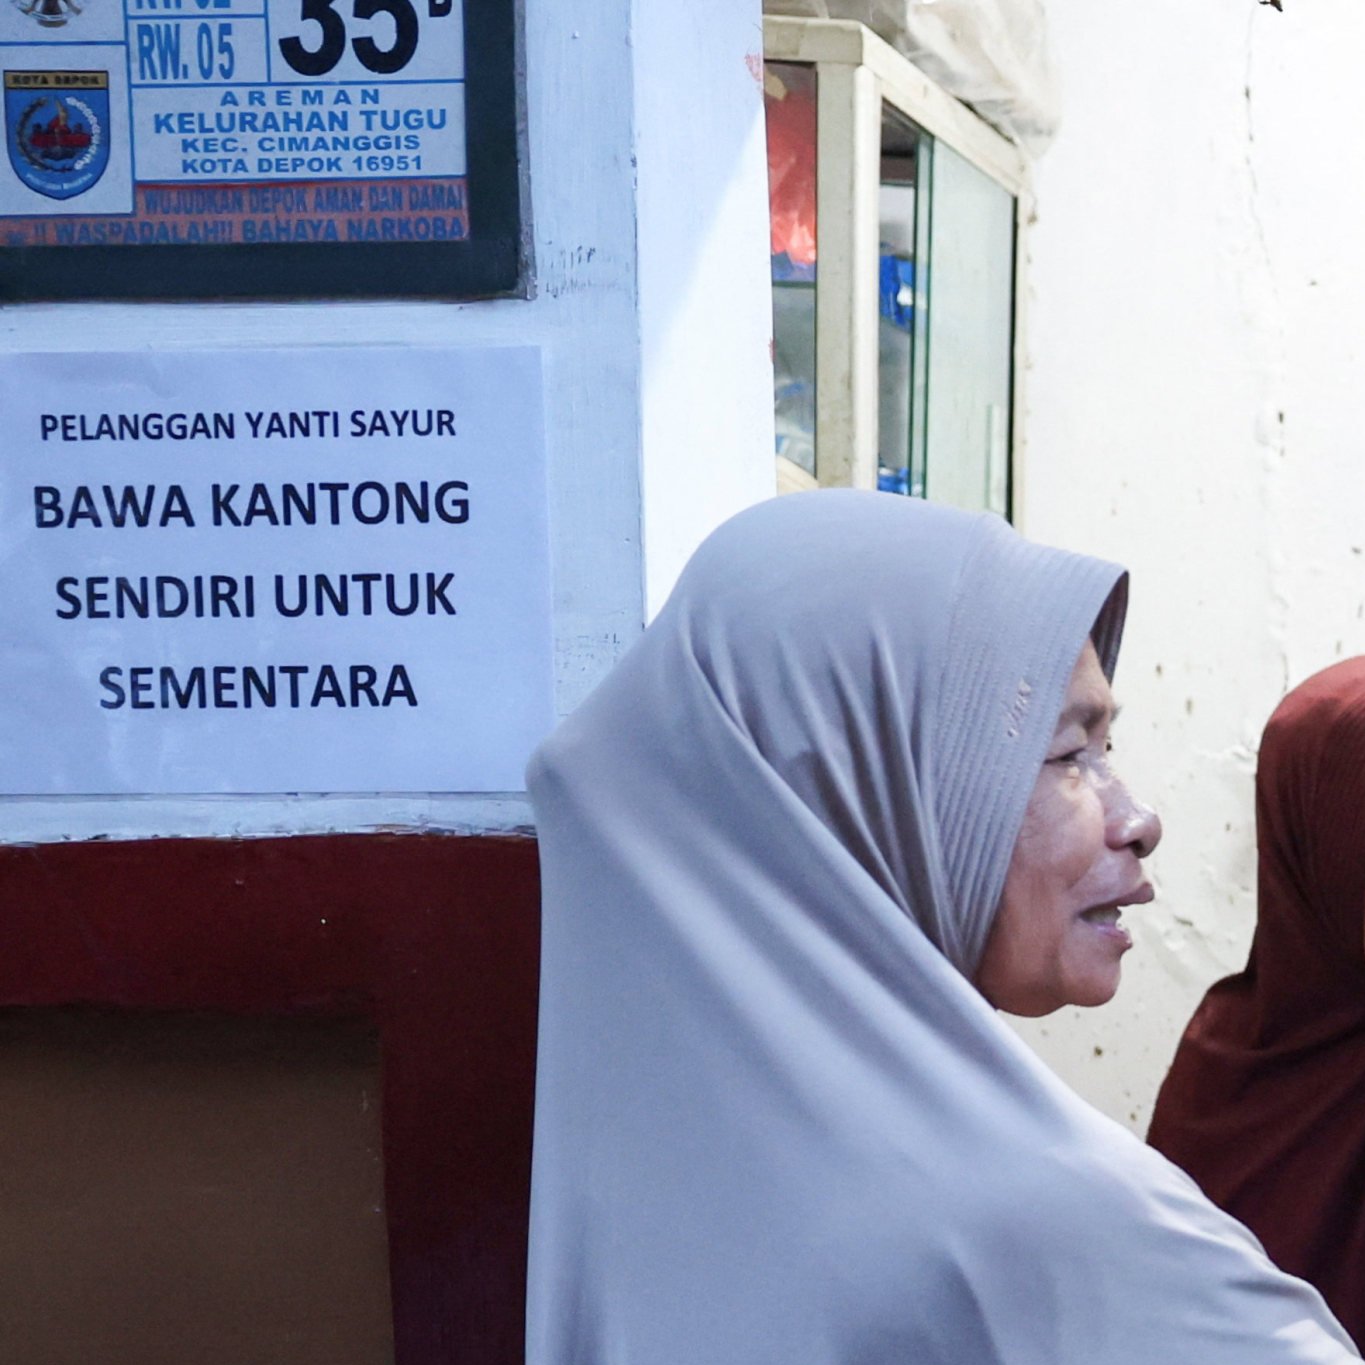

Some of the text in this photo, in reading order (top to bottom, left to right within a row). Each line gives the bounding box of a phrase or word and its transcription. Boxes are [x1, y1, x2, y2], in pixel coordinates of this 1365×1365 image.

[137, 22, 234, 80] RW. 05
[278, 0, 419, 76] 35
[220, 88, 379, 107] AREMAN
[154, 108, 447, 134] KELURAHAN TUGU
[181, 134, 421, 153] KEC. CIMANGGIS
[182, 154, 422, 174] KOTA DEPOK 16951
[145, 185, 463, 214] WUJUDKAN DEPOK AMAN DAN DAMAI
[242, 219, 339, 242] BAHAYA
[347, 216, 464, 242] NARKOBA
[39, 408, 457, 442] PELANGGAN YANTI SAYUR
[33, 480, 471, 529] BAWA KANTONG
[55, 571, 457, 620] SENDIRI UNTUK
[99, 663, 419, 710] SEMENTARA
